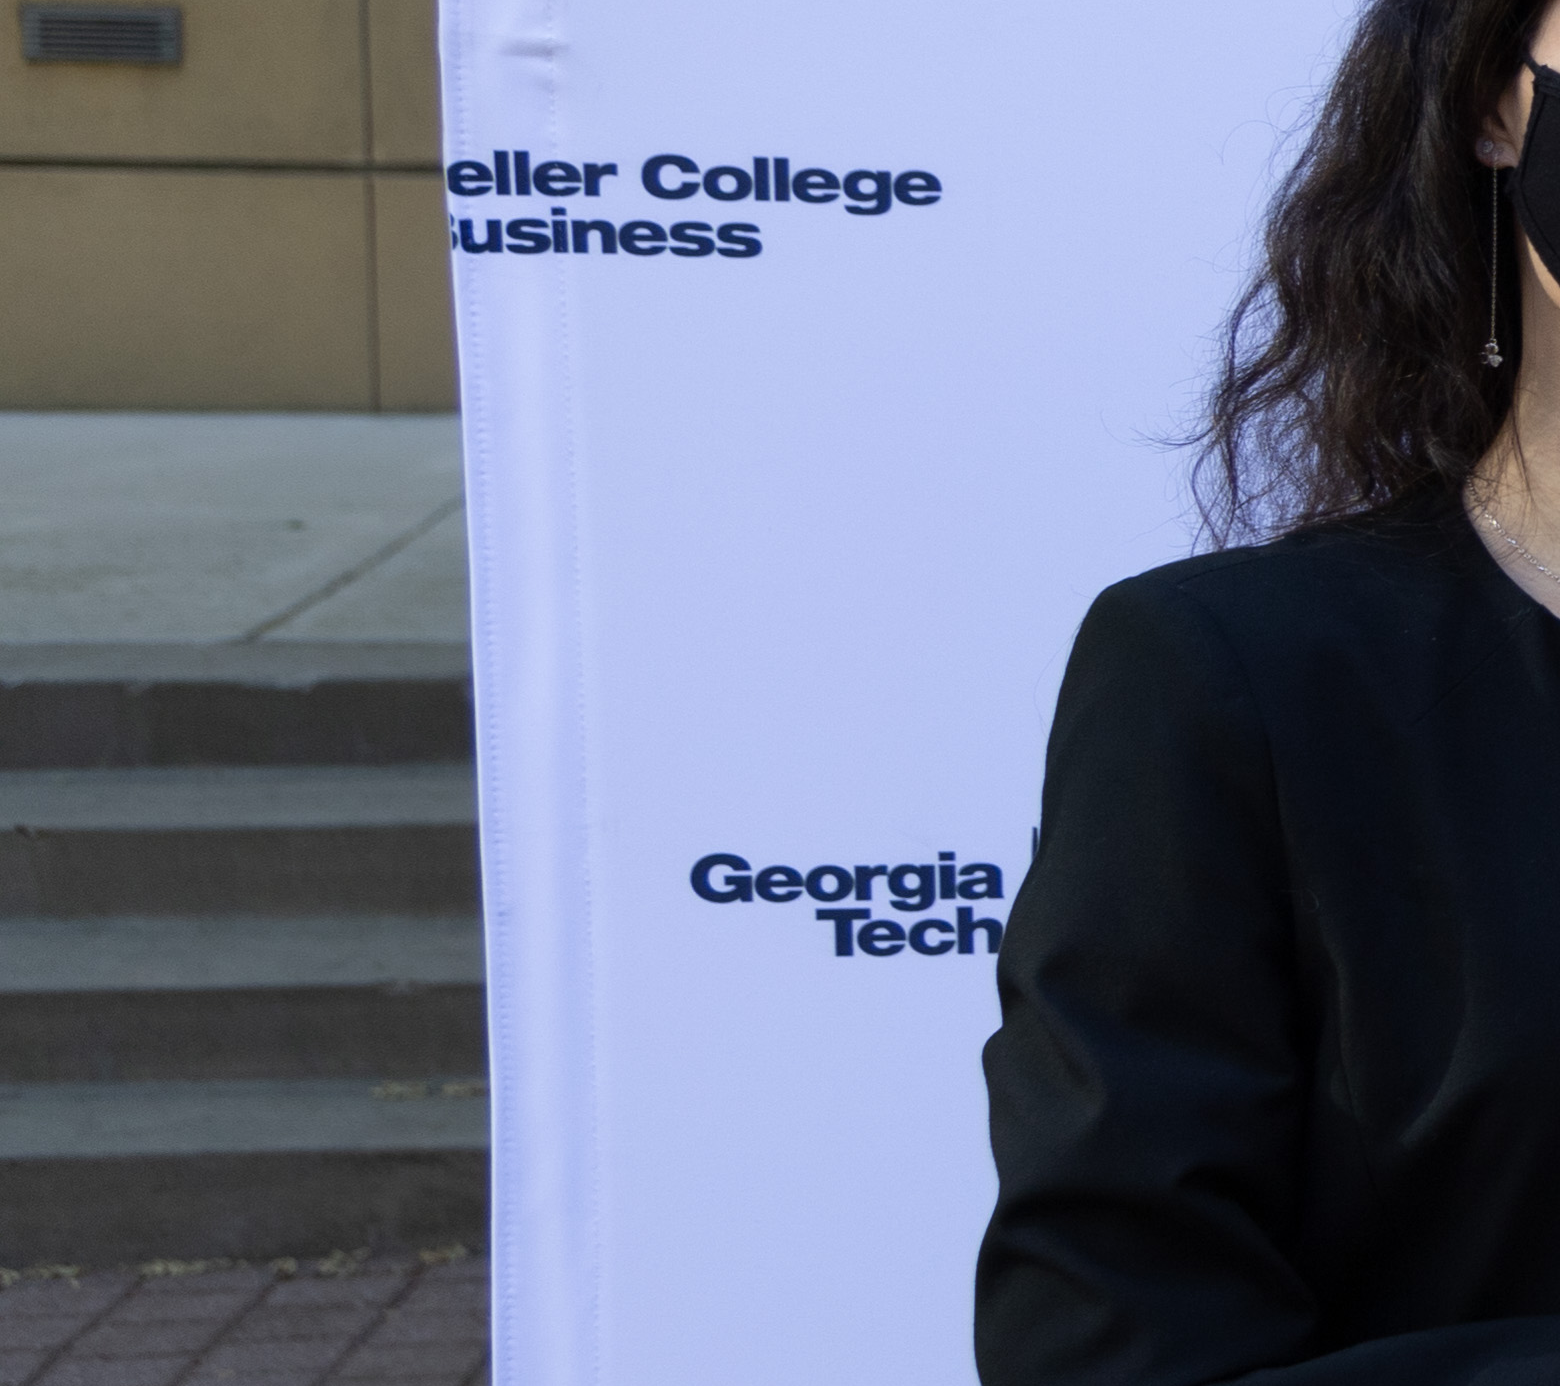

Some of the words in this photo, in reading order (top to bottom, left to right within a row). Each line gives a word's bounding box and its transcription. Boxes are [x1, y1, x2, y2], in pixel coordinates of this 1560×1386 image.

[642, 155, 941, 215] College
[449, 210, 763, 258] usiness
[691, 852, 1003, 912] Georgia
[815, 906, 1002, 958] Tech
